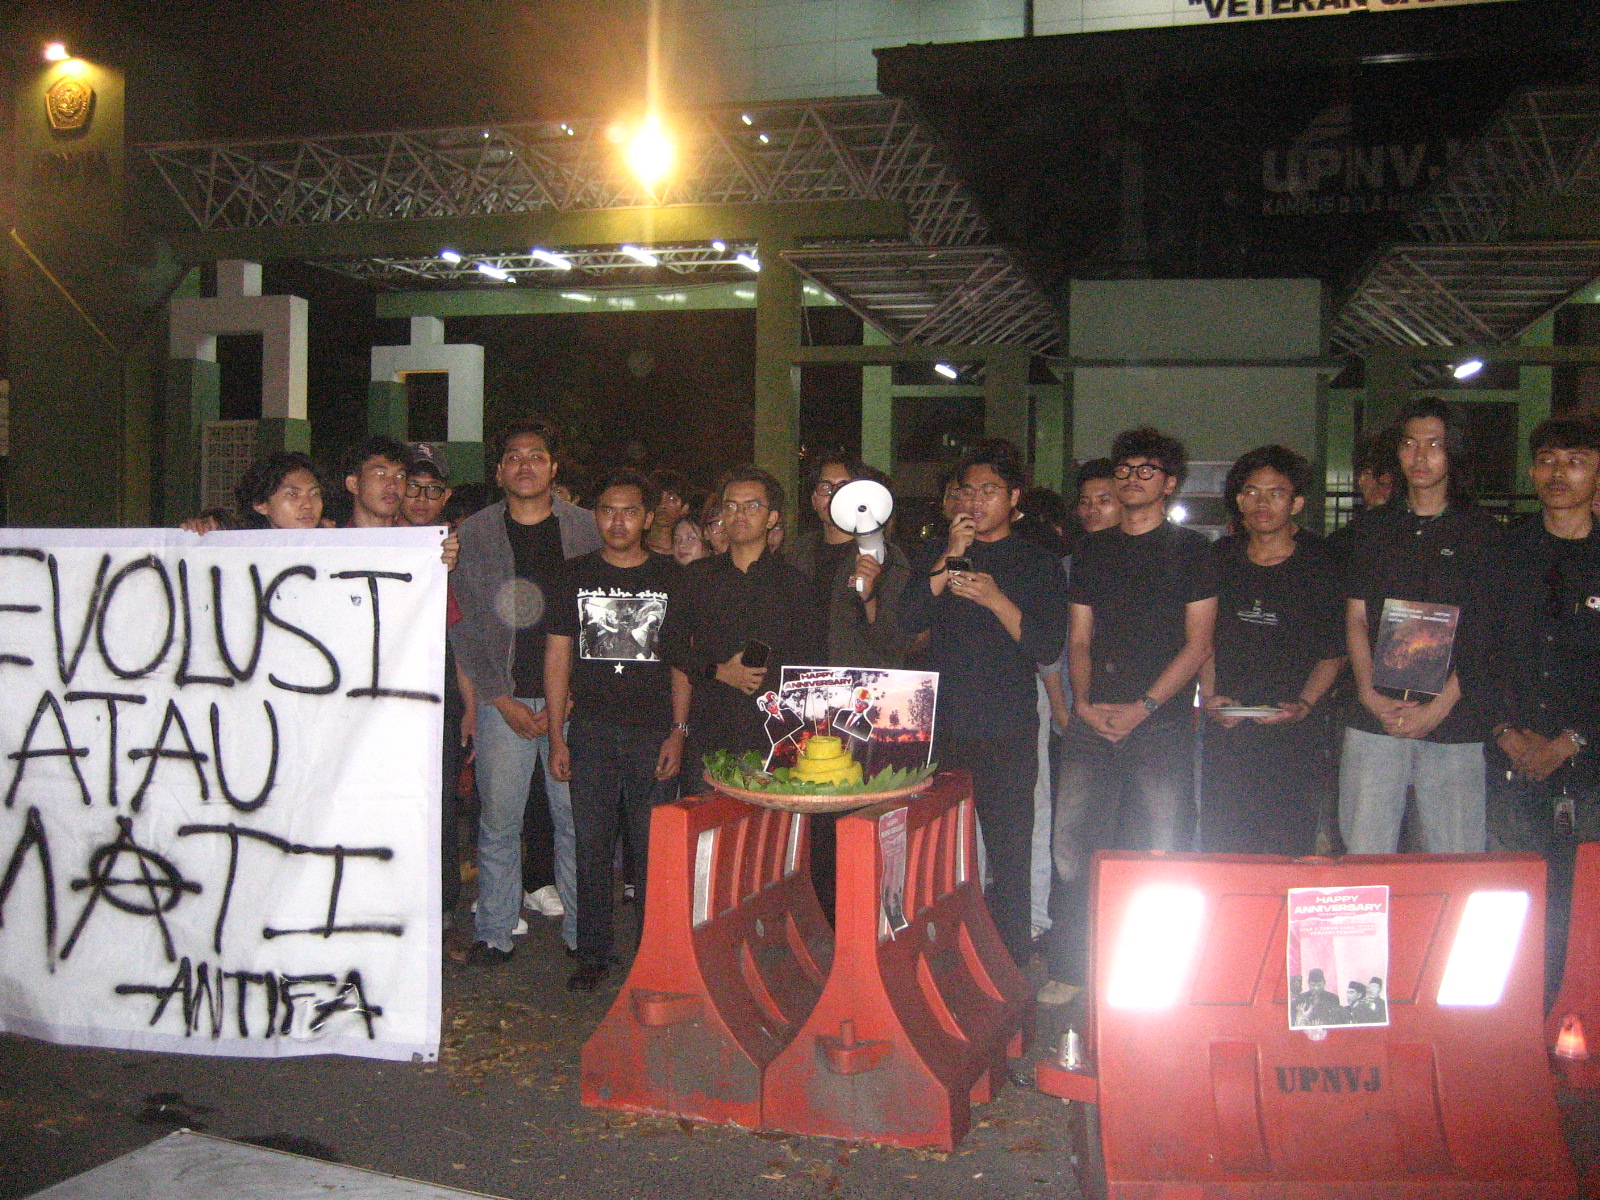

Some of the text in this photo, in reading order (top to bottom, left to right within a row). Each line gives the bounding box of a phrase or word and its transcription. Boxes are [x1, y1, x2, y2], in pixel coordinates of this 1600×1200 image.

[0, 548, 442, 703] EVOLUSI
[800, 672, 835, 680] HAPPY
[784, 678, 852, 690] ANNIVERSARY
[3, 690, 280, 813] ATAU
[1316, 895, 1359, 904] HAPPY
[1294, 904, 1382, 914] ANNIVERSARY
[1275, 1066, 1381, 1093] UPNVJ
